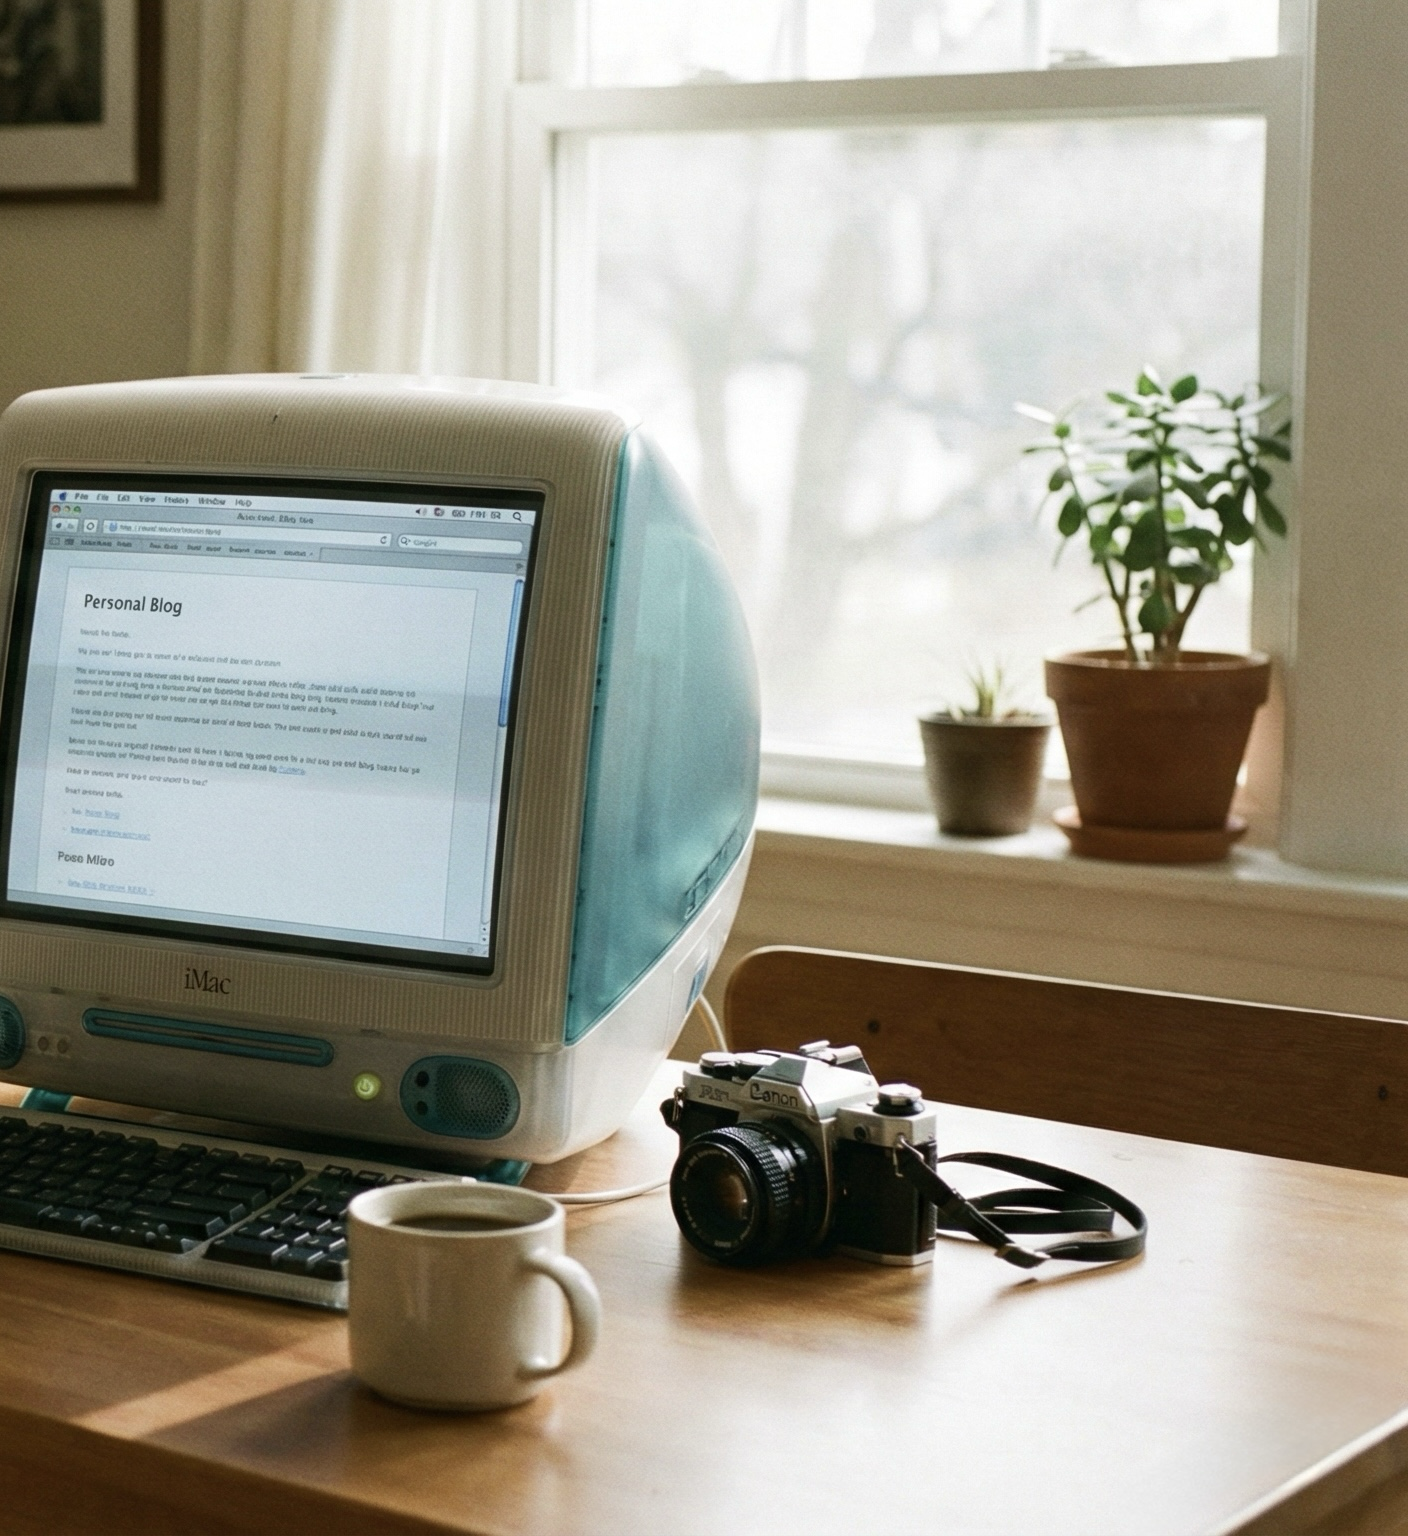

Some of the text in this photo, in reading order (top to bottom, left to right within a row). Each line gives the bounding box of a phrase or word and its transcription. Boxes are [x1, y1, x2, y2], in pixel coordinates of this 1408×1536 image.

[84, 593, 183, 617] Personal Blog
[184, 967, 231, 995] iMac
[750, 1083, 798, 1107] Canon
